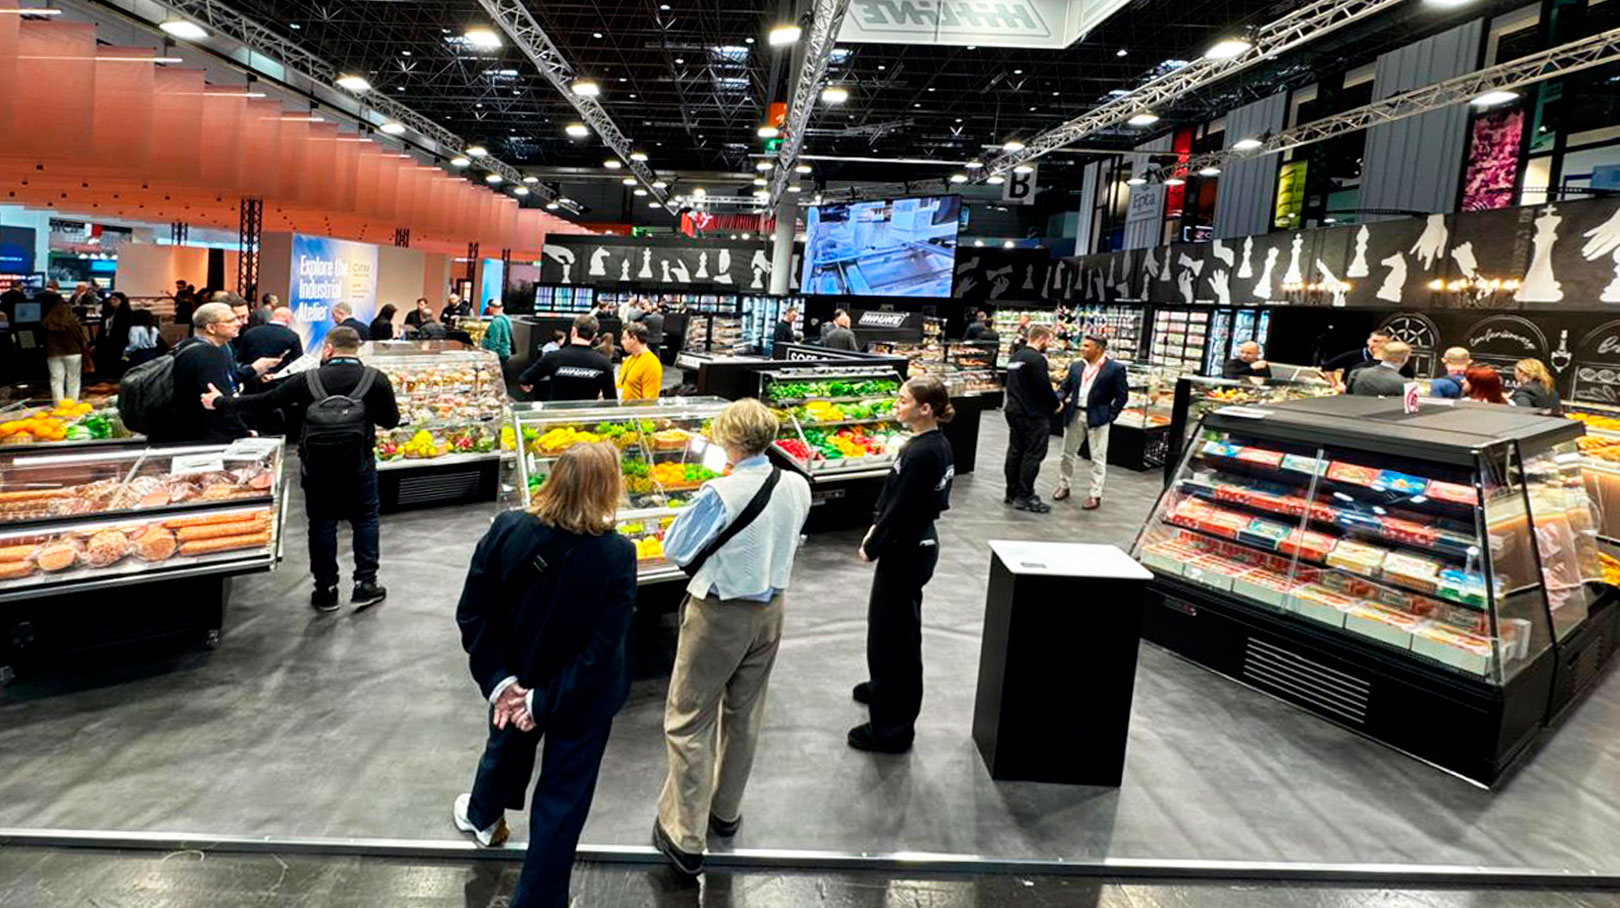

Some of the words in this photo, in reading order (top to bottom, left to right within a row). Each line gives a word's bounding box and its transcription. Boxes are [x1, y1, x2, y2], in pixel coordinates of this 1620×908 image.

[300, 254, 333, 281] Explore
[334, 257, 349, 276] the
[298, 277, 342, 299] Industrial
[297, 302, 328, 322] Atelier
